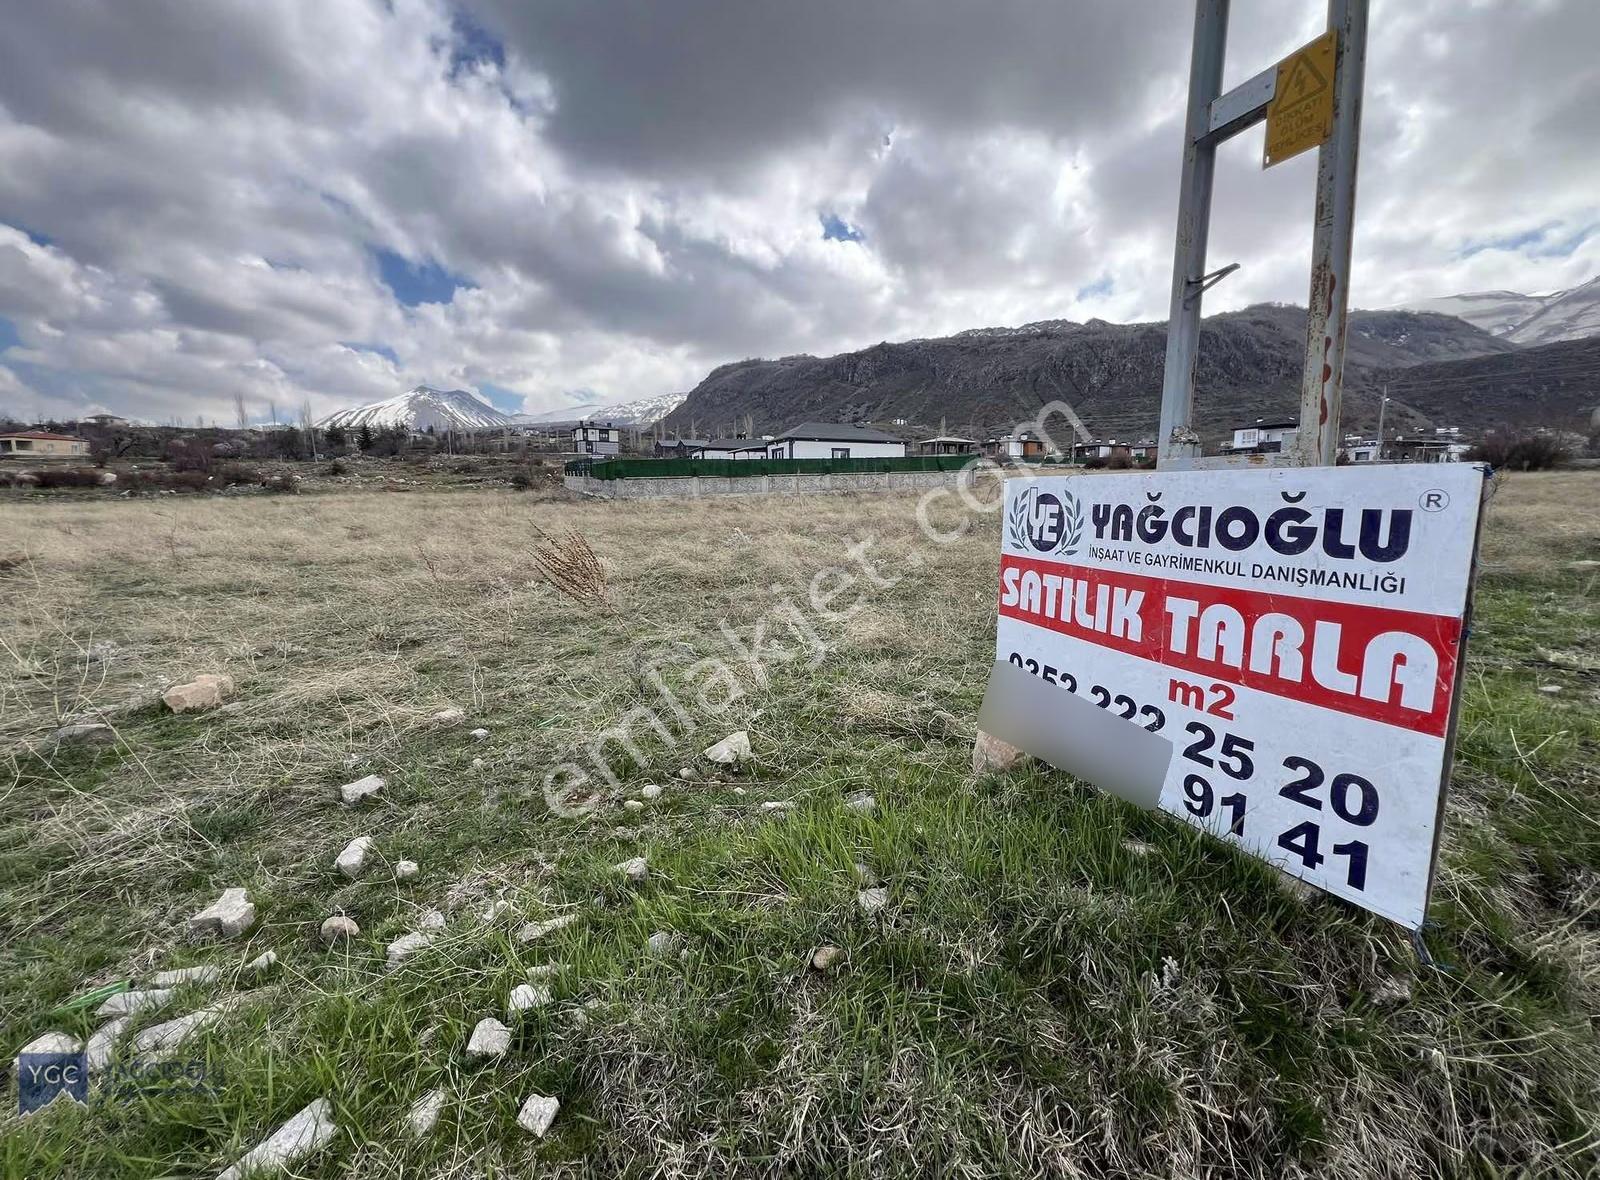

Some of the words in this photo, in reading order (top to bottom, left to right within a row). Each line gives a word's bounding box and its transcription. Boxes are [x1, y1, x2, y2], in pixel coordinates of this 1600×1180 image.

[1088, 544, 1125, 562] İNŞAAT
[1127, 551, 1141, 565] VE
[1144, 553, 1246, 577] GAYRİMENKUL
[1251, 564, 1406, 595] DANIŞMANLIĞI
[1092, 491, 1414, 563] YAĞCIOĞLU
[1001, 567, 1146, 643] SATILIK
[1165, 597, 1439, 714] TARLA
[1168, 678, 1236, 721] m2
[1182, 721, 1255, 780] 25
[1278, 756, 1380, 827] 20
[1183, 773, 1248, 837] 91
[1277, 820, 1369, 892] 41
